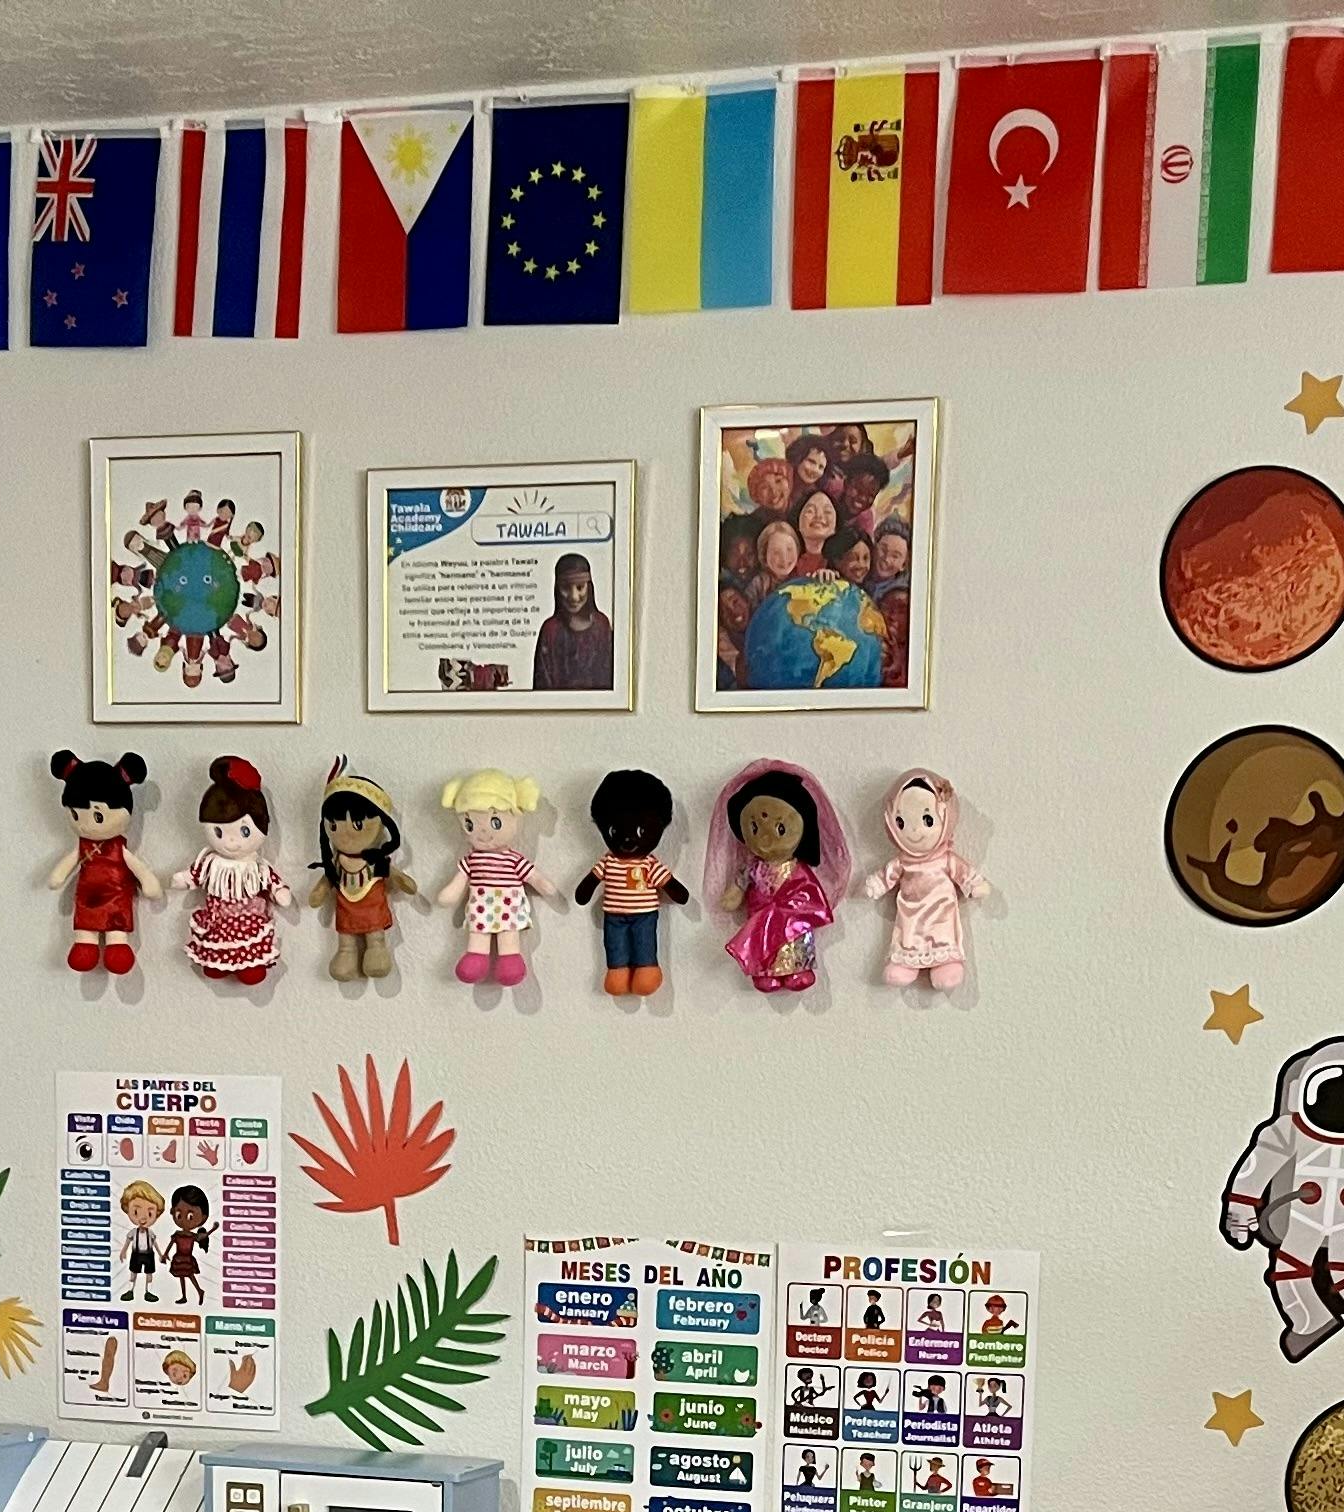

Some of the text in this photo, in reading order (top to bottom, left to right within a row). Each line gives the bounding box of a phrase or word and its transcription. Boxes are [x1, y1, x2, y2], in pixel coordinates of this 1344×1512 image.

[390, 503, 431, 513] Tawala
[390, 514, 442, 524] Academy
[390, 523, 443, 533] Childcare
[496, 521, 567, 538] TAWALA
[117, 1078, 216, 1092] LAS PARTES DEL
[116, 1093, 217, 1113] CUERPO
[562, 1260, 743, 1289] MESES DEL AÑO
[824, 1252, 991, 1286] PROFESIÓN
[556, 1290, 613, 1306] enero
[668, 1295, 735, 1314] febrero
[559, 1306, 609, 1321] January
[672, 1314, 730, 1330] February
[795, 1331, 832, 1344] Doctora
[908, 1336, 960, 1350] Enfermera
[563, 1343, 616, 1358] marzo
[798, 1344, 829, 1355] Doctor
[857, 1347, 889, 1358] Police
[968, 1339, 1024, 1353] Bombero
[681, 1349, 723, 1365] abril
[918, 1350, 949, 1361] Nurse
[968, 1353, 1023, 1365] Firefighter
[568, 1358, 609, 1372] March
[685, 1366, 718, 1379] April
[564, 1393, 611, 1409] mayo
[678, 1398, 725, 1416] junio
[571, 1407, 598, 1422] May
[789, 1412, 834, 1426] Músico
[683, 1416, 717, 1430] June
[844, 1416, 897, 1429] Profesora
[904, 1419, 958, 1432] Periodista
[973, 1422, 1012, 1435] Atleta
[789, 1425, 833, 1437] Musician
[852, 1428, 892, 1440] Teacher
[905, 1433, 956, 1444] Journalist
[973, 1435, 1011, 1447] Athlete
[565, 1444, 603, 1462] julio
[669, 1452, 731, 1470] agosto
[570, 1462, 598, 1476] July
[676, 1470, 721, 1485] August
[546, 1494, 627, 1512] septiembre
[783, 1492, 834, 1506] Peluquera
[848, 1495, 887, 1508] Pintor
